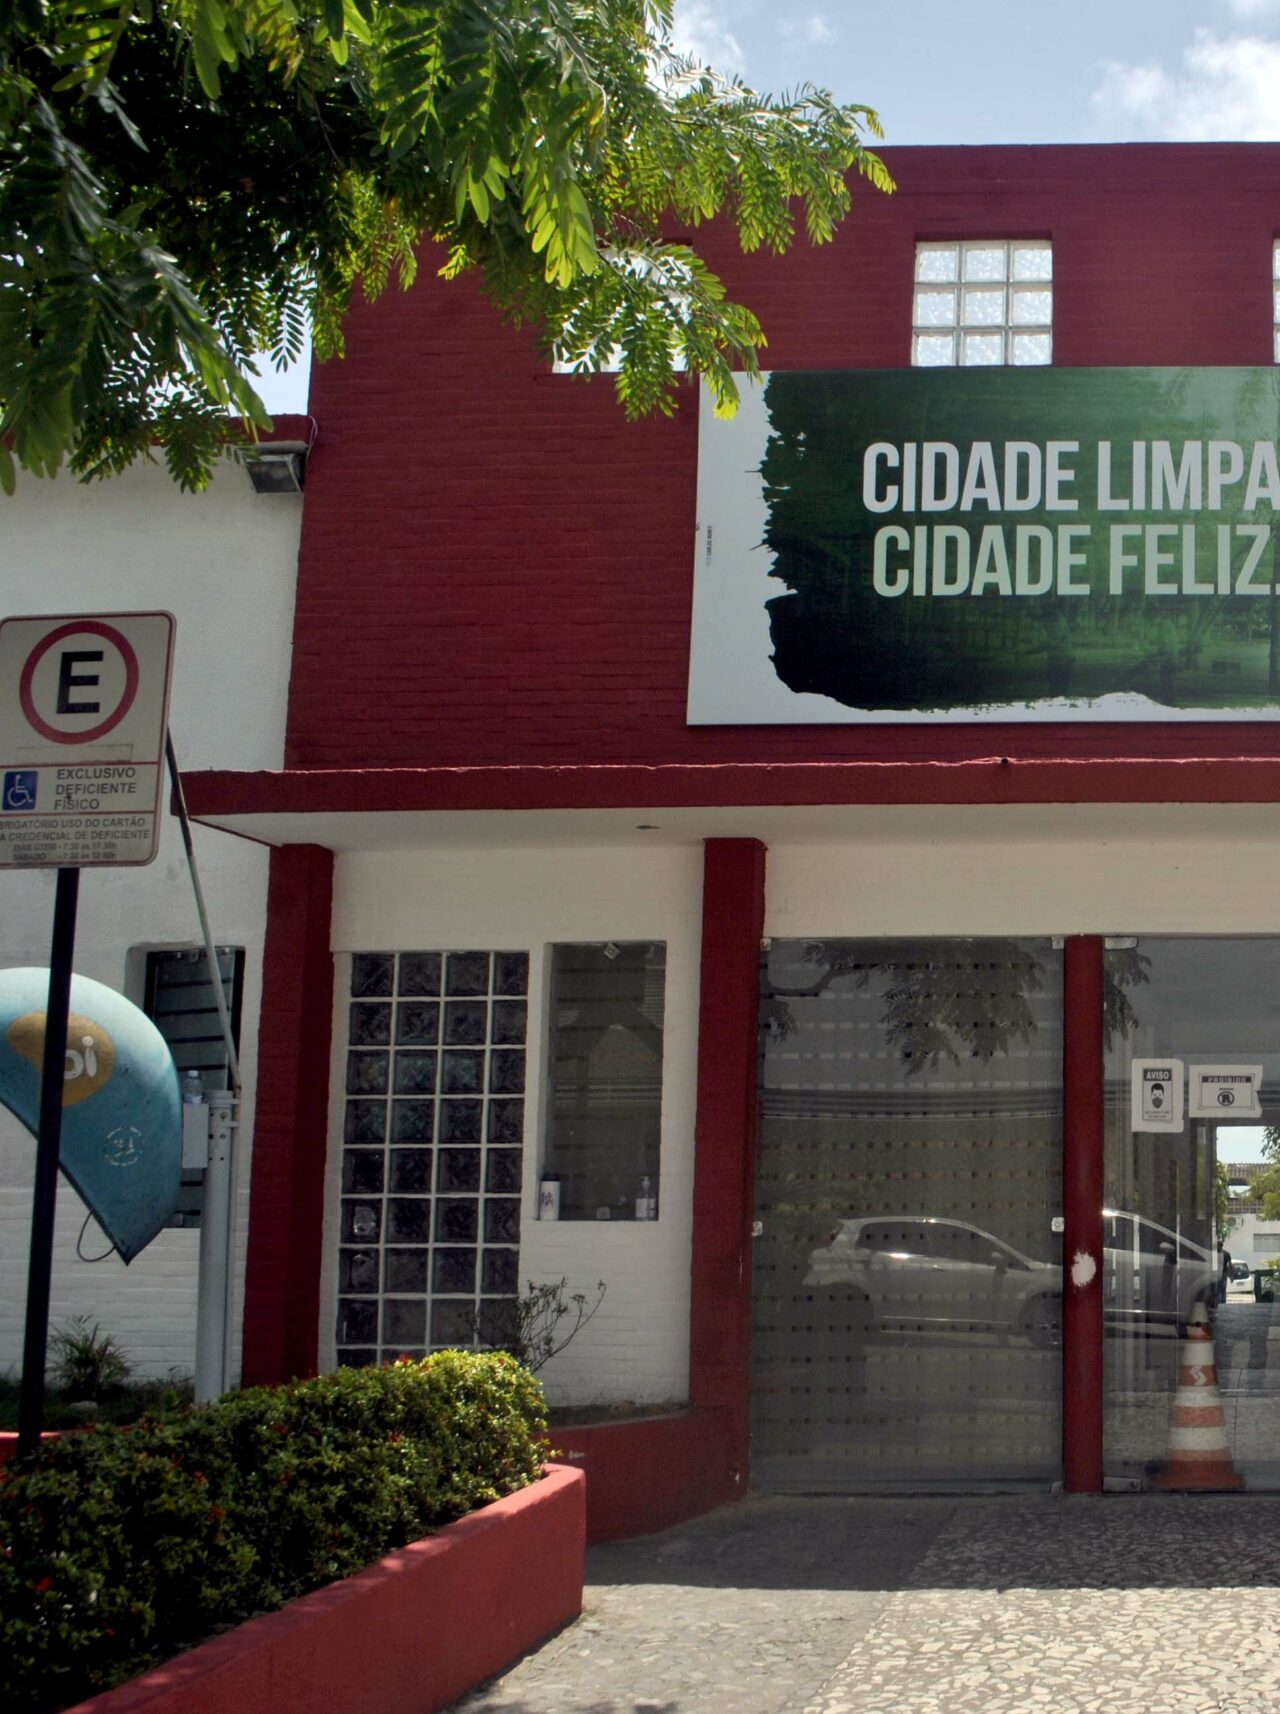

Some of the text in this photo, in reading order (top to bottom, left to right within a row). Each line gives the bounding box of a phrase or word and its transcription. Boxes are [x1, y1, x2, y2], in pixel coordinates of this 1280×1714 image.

[863, 441, 1079, 513] CIDADE
[873, 525, 1090, 597] CIDADE
[56, 650, 104, 715] E
[57, 767, 136, 780] EXCLUSIVO
[55, 782, 137, 795] DEFICIENTE
[0, 815, 146, 830] BRIGATÓRIO USO DO CARTÃO
[8, 831, 72, 842] CREDENCIAL
[75, 830, 89, 840] DE
[91, 829, 151, 839] DEFICIENTE
[1146, 1071, 1170, 1080] AVISO
